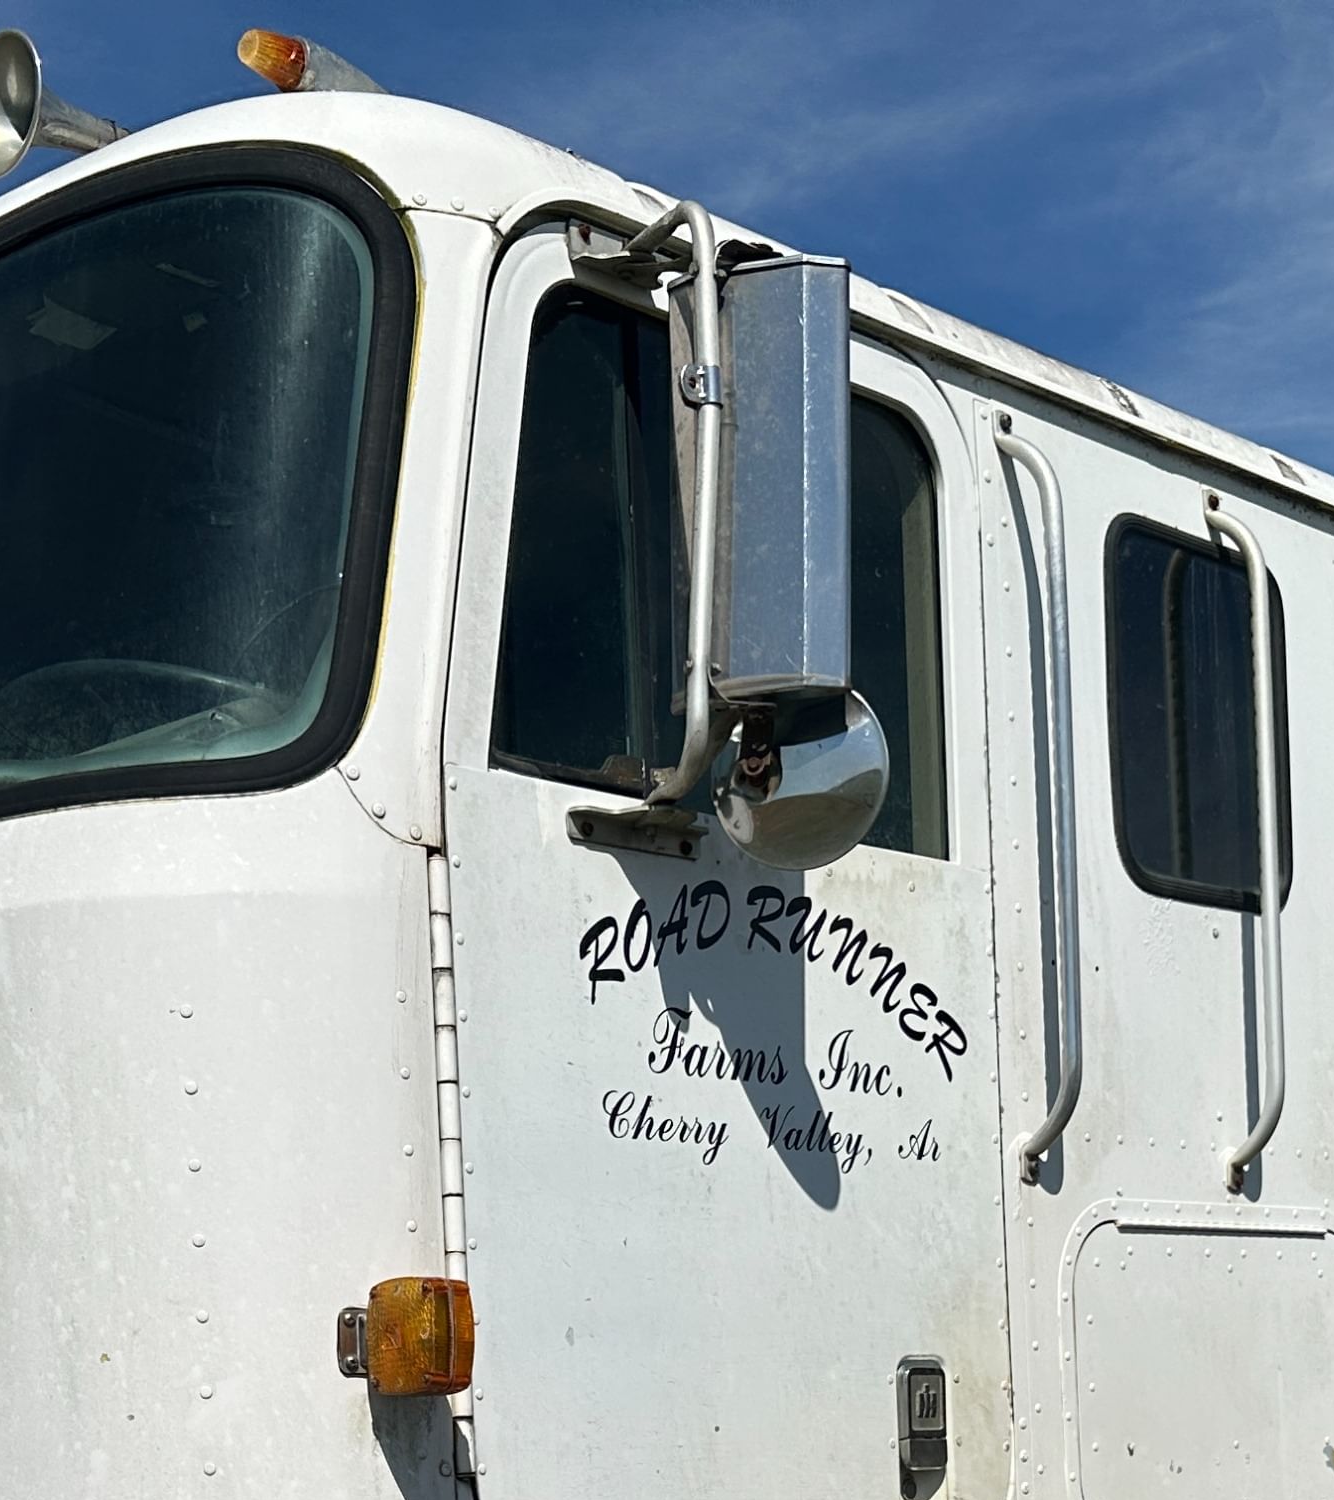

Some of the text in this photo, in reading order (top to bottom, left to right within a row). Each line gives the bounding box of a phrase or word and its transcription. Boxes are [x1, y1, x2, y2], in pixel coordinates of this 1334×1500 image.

[579, 880, 969, 1082] ROAD RUNNER
[648, 1007, 904, 1098] Farms Inc.
[601, 1089, 942, 1174] Cherry Valley, Ar
